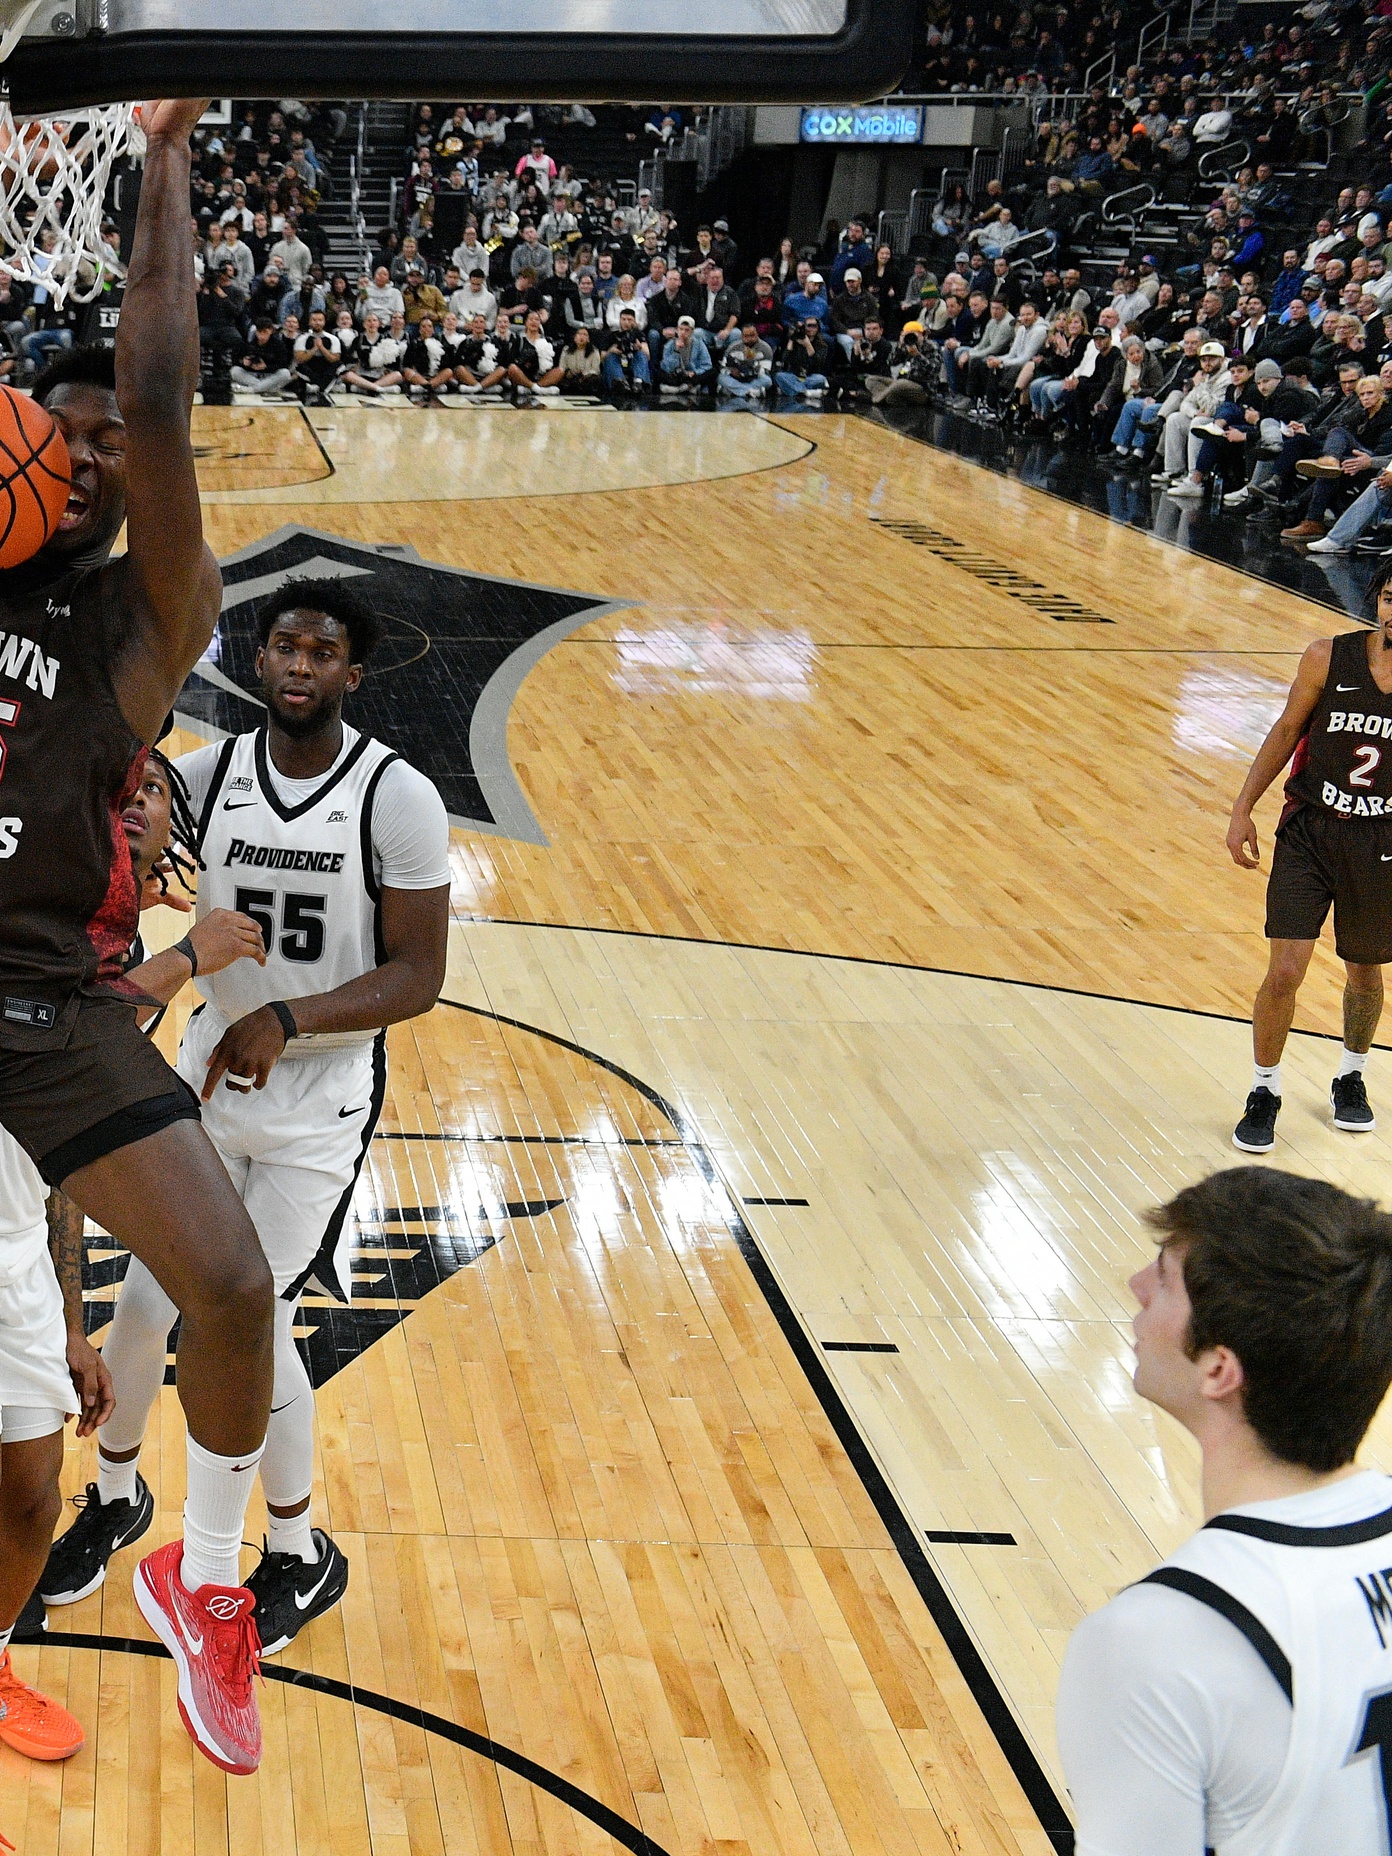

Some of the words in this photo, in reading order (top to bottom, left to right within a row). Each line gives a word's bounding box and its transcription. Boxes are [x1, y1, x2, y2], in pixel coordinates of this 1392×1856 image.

[805, 115, 853, 136] COX
[1349, 743, 1382, 788] 2
[222, 837, 346, 874] PROVIDENCE
[234, 885, 328, 965] 55
[37, 1008, 49, 1020] XL
